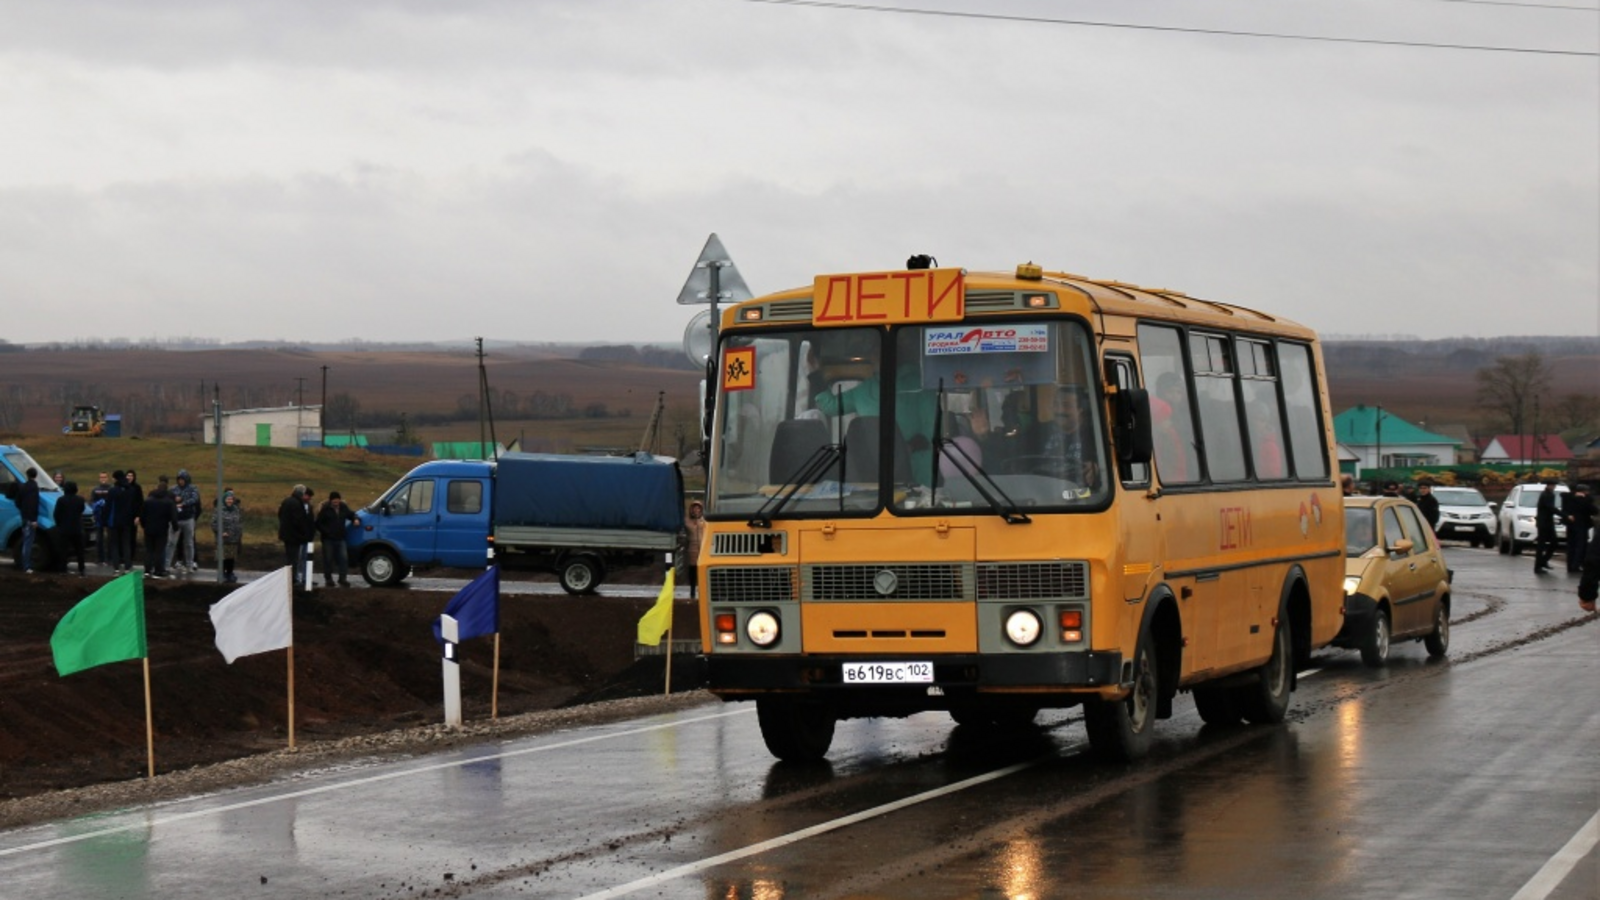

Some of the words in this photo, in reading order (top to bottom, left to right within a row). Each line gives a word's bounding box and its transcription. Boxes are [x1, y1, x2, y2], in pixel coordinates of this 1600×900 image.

[815, 271, 963, 322] ДЕТИ
[927, 346, 971, 354] АВТОБУСОВ
[1219, 505, 1253, 551] ДЕТИ
